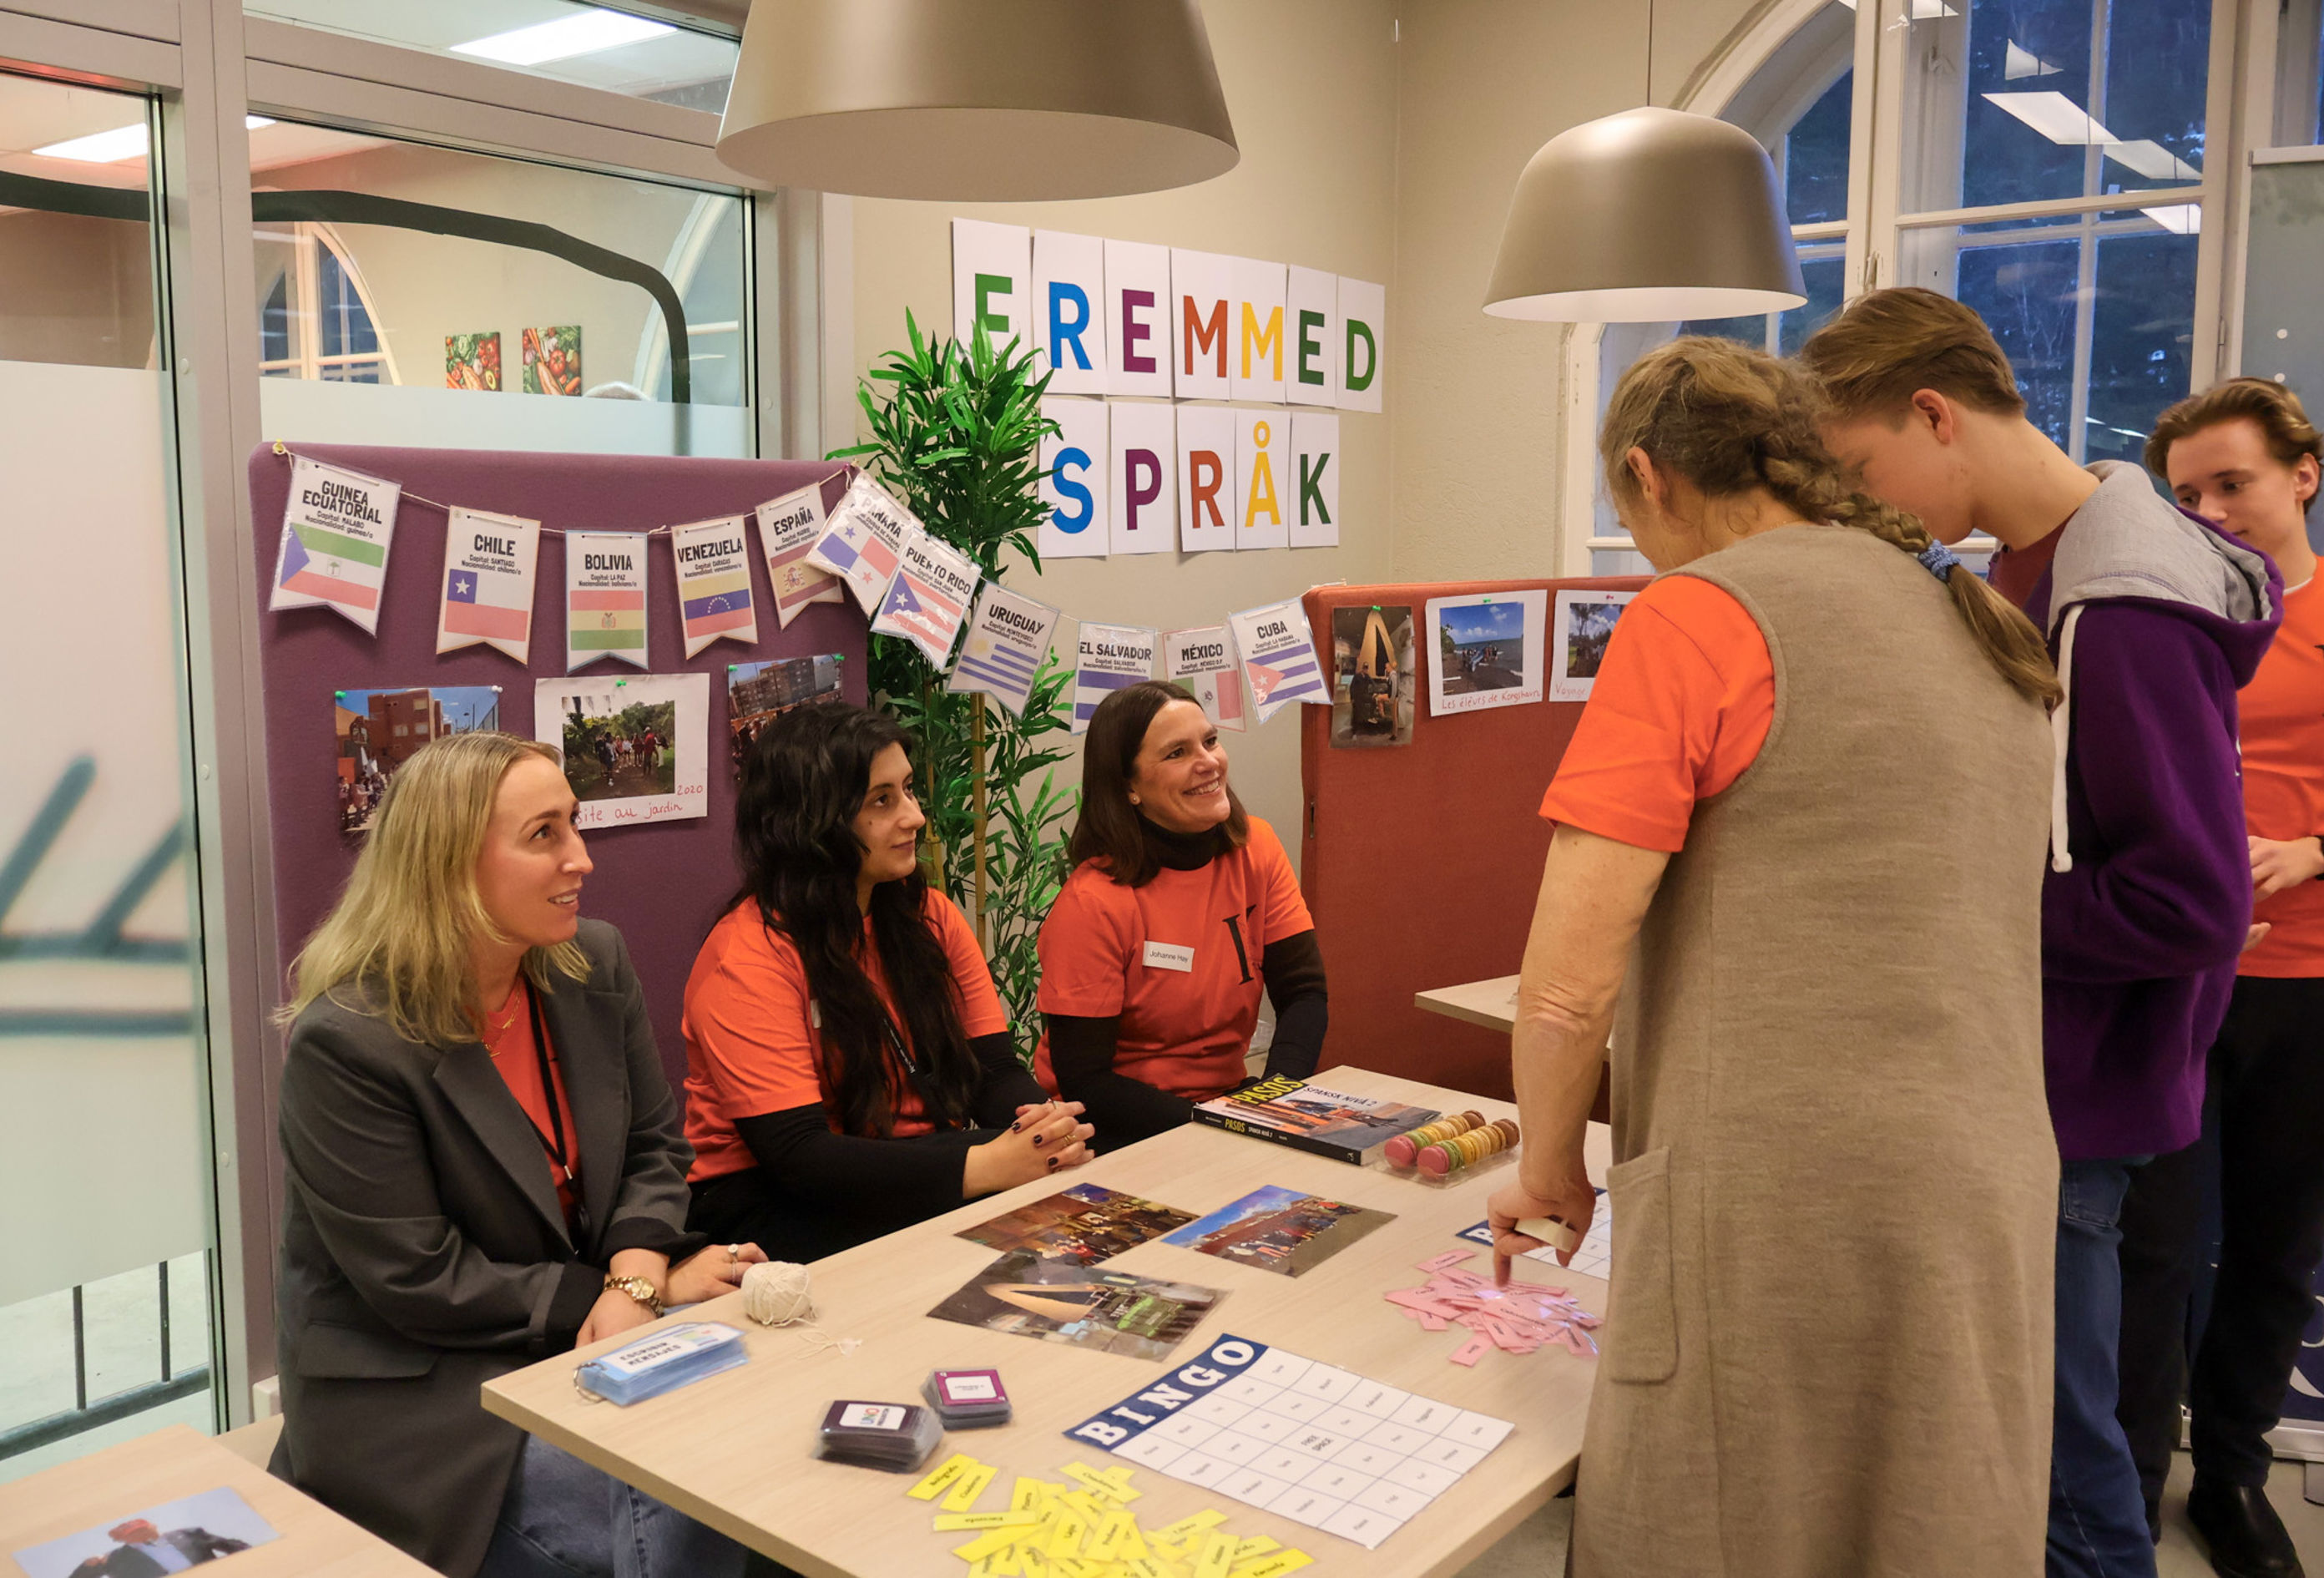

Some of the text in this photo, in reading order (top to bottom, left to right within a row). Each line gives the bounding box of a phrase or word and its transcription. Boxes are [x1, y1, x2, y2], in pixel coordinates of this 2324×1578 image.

[974, 273, 1377, 392] FREMMED
[1051, 420, 1331, 535] SPRÅK
[321, 480, 368, 506] GUINEA
[302, 489, 382, 524] ECUATORIAL
[305, 514, 345, 531] Nacionalidad:
[316, 510, 365, 529] Capital: MALABO
[773, 506, 815, 536] ESPAÑA
[474, 534, 516, 556] CHILE
[677, 537, 744, 564] VENEZUELA
[461, 559, 496, 572] Nacionalidad:
[469, 554, 515, 568] Capital: SANTIAGO
[584, 554, 634, 570] BOLIVIA
[905, 547, 972, 595] PUERTO RICO
[590, 574, 609, 582] Capital:
[988, 604, 1045, 635] URUGUAY
[1007, 627, 1033, 642] MONTEVIDEO
[1256, 620, 1288, 640] CUBA
[1079, 641, 1152, 661] EL SALVADOR
[1181, 643, 1224, 661] MÉXICO
[1555, 683, 1586, 700] Voyage
[1442, 699, 1456, 710] Les
[1488, 695, 1498, 703] de
[676, 785, 704, 797] 2020
[614, 808, 638, 819] au
[644, 801, 683, 820] jardin
[1149, 950, 1176, 960] Johanne
[1231, 1075, 1305, 1105] PASOS
[1304, 1086, 1342, 1099] SPANSK
[1344, 1095, 1368, 1107] NIVÅ
[1225, 1118, 1246, 1133] PASOS
[628, 1344, 682, 1366] MENSAJES
[1074, 1341, 1255, 1446] BINGO
